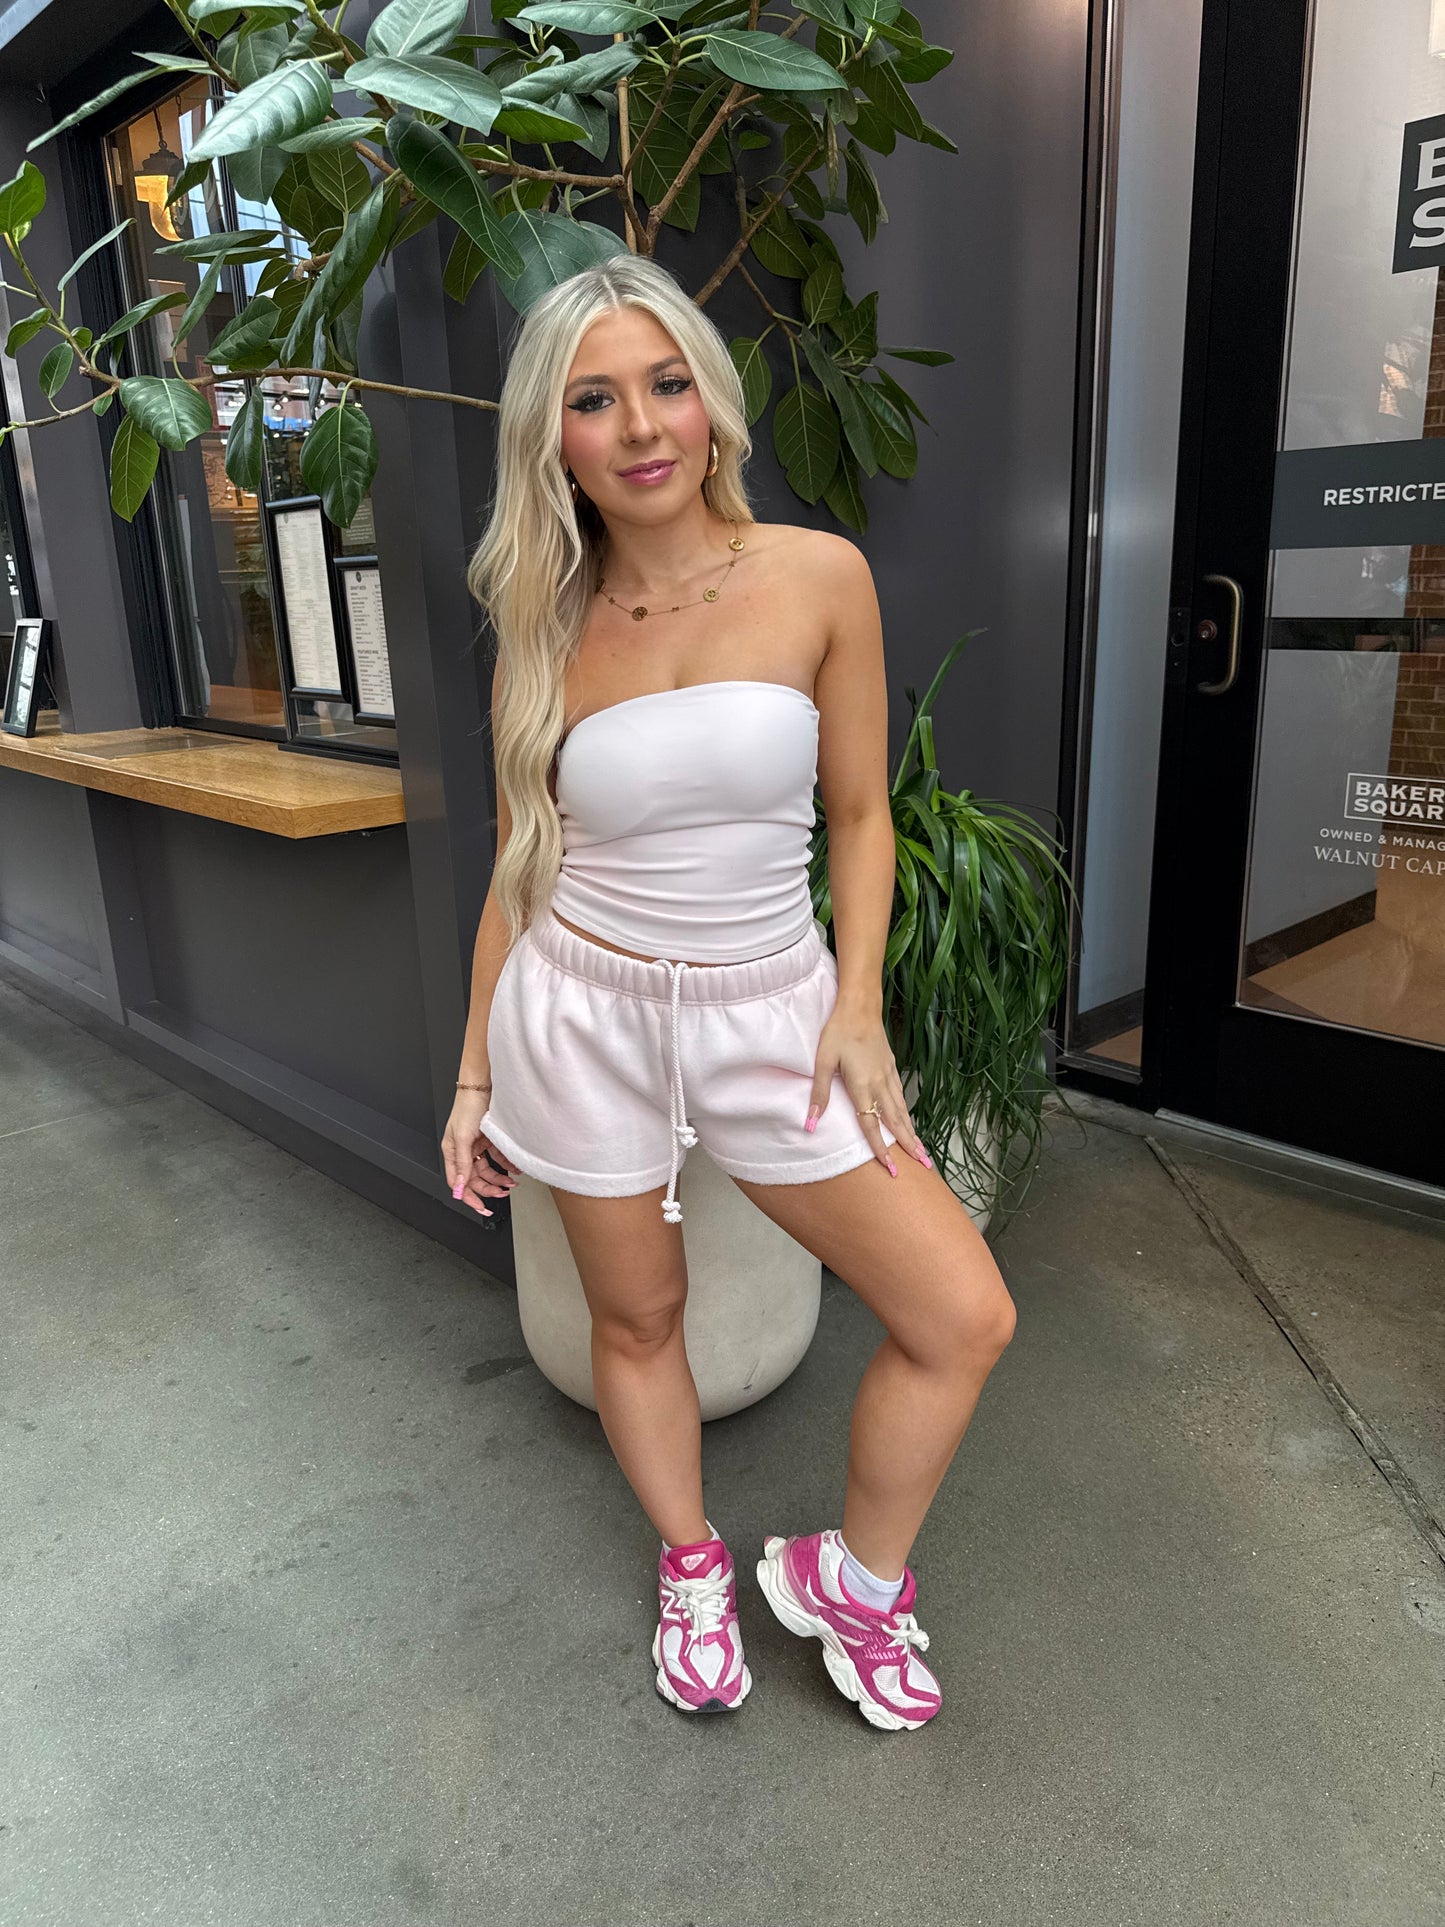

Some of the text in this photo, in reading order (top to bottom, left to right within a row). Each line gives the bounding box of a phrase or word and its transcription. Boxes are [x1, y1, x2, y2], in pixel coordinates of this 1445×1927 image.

[1323, 483, 1445, 506] RESTRICTE
[1355, 781, 1445, 804] BAKER
[1353, 798, 1444, 820] SQUAR
[1320, 828, 1445, 852] OWNED & MANAG
[1313, 845, 1400, 870] WALNUT
